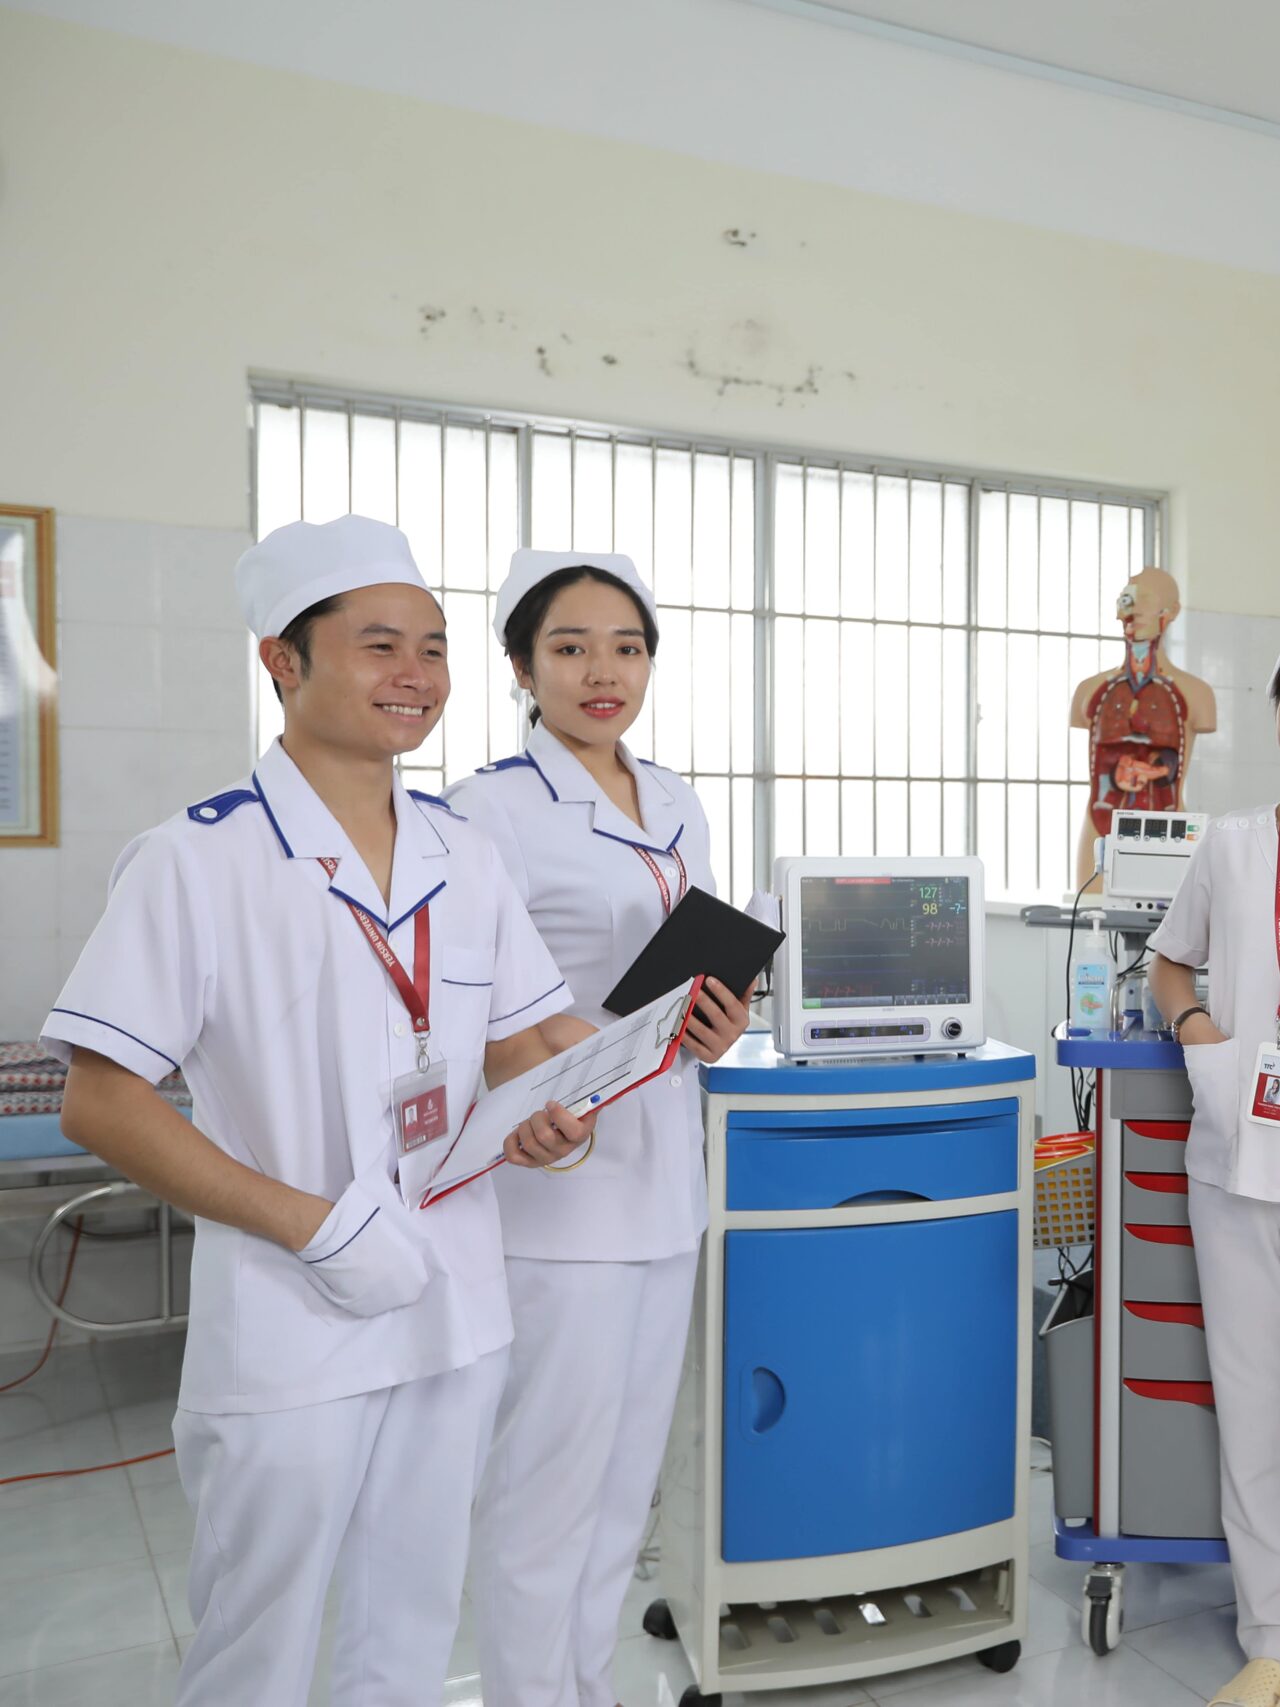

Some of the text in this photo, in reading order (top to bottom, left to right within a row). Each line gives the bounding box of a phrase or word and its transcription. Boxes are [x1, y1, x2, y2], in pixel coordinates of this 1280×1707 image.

[920, 887, 937, 899] 127
[922, 903, 938, 915] 98
[375, 940, 397, 967] YERSIN
